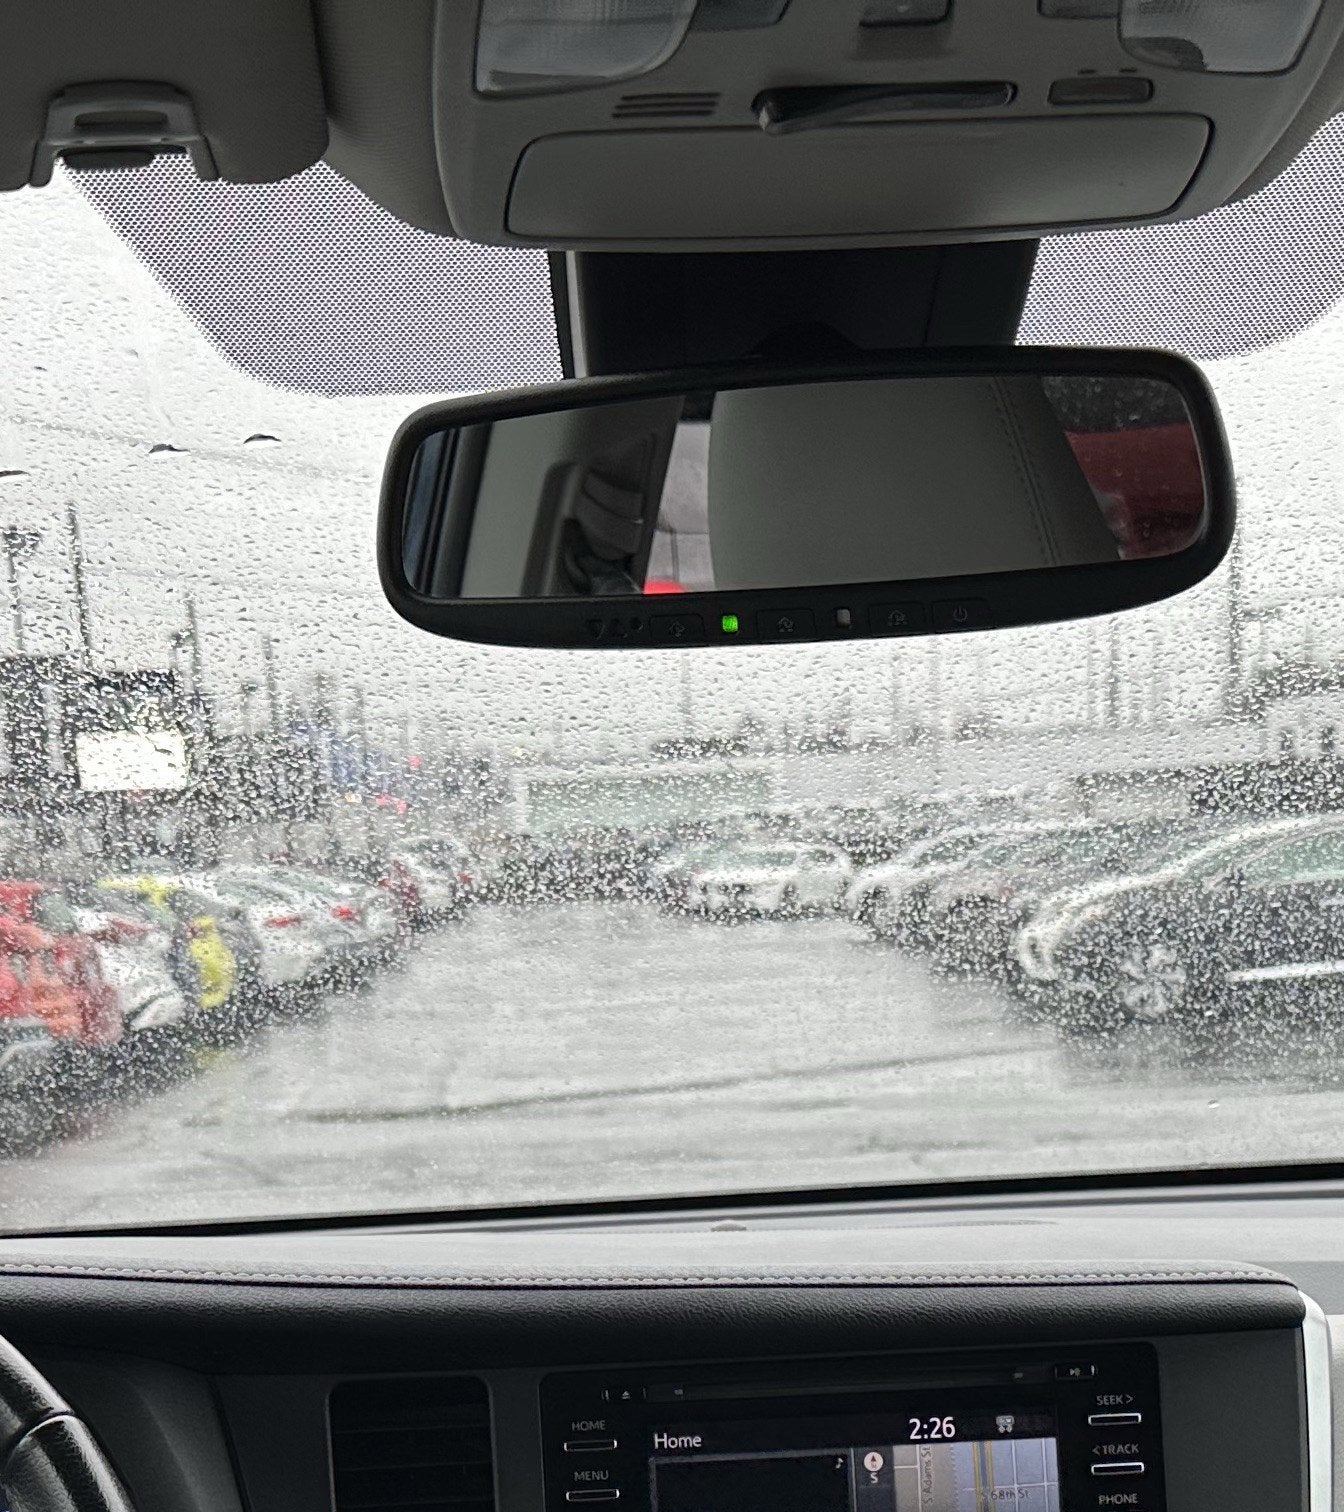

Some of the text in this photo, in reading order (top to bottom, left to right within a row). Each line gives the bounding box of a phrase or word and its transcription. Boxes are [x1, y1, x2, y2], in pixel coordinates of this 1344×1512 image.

[1096, 1395, 1123, 1406] SEEK
[571, 1420, 606, 1432] HOME
[908, 1415, 956, 1440] 2:26
[654, 1433, 702, 1449] Home
[1103, 1443, 1140, 1455] TRACK
[574, 1469, 609, 1481] MENU
[990, 1490, 1016, 1500] 68th
[1098, 1493, 1139, 1505] PHONE
